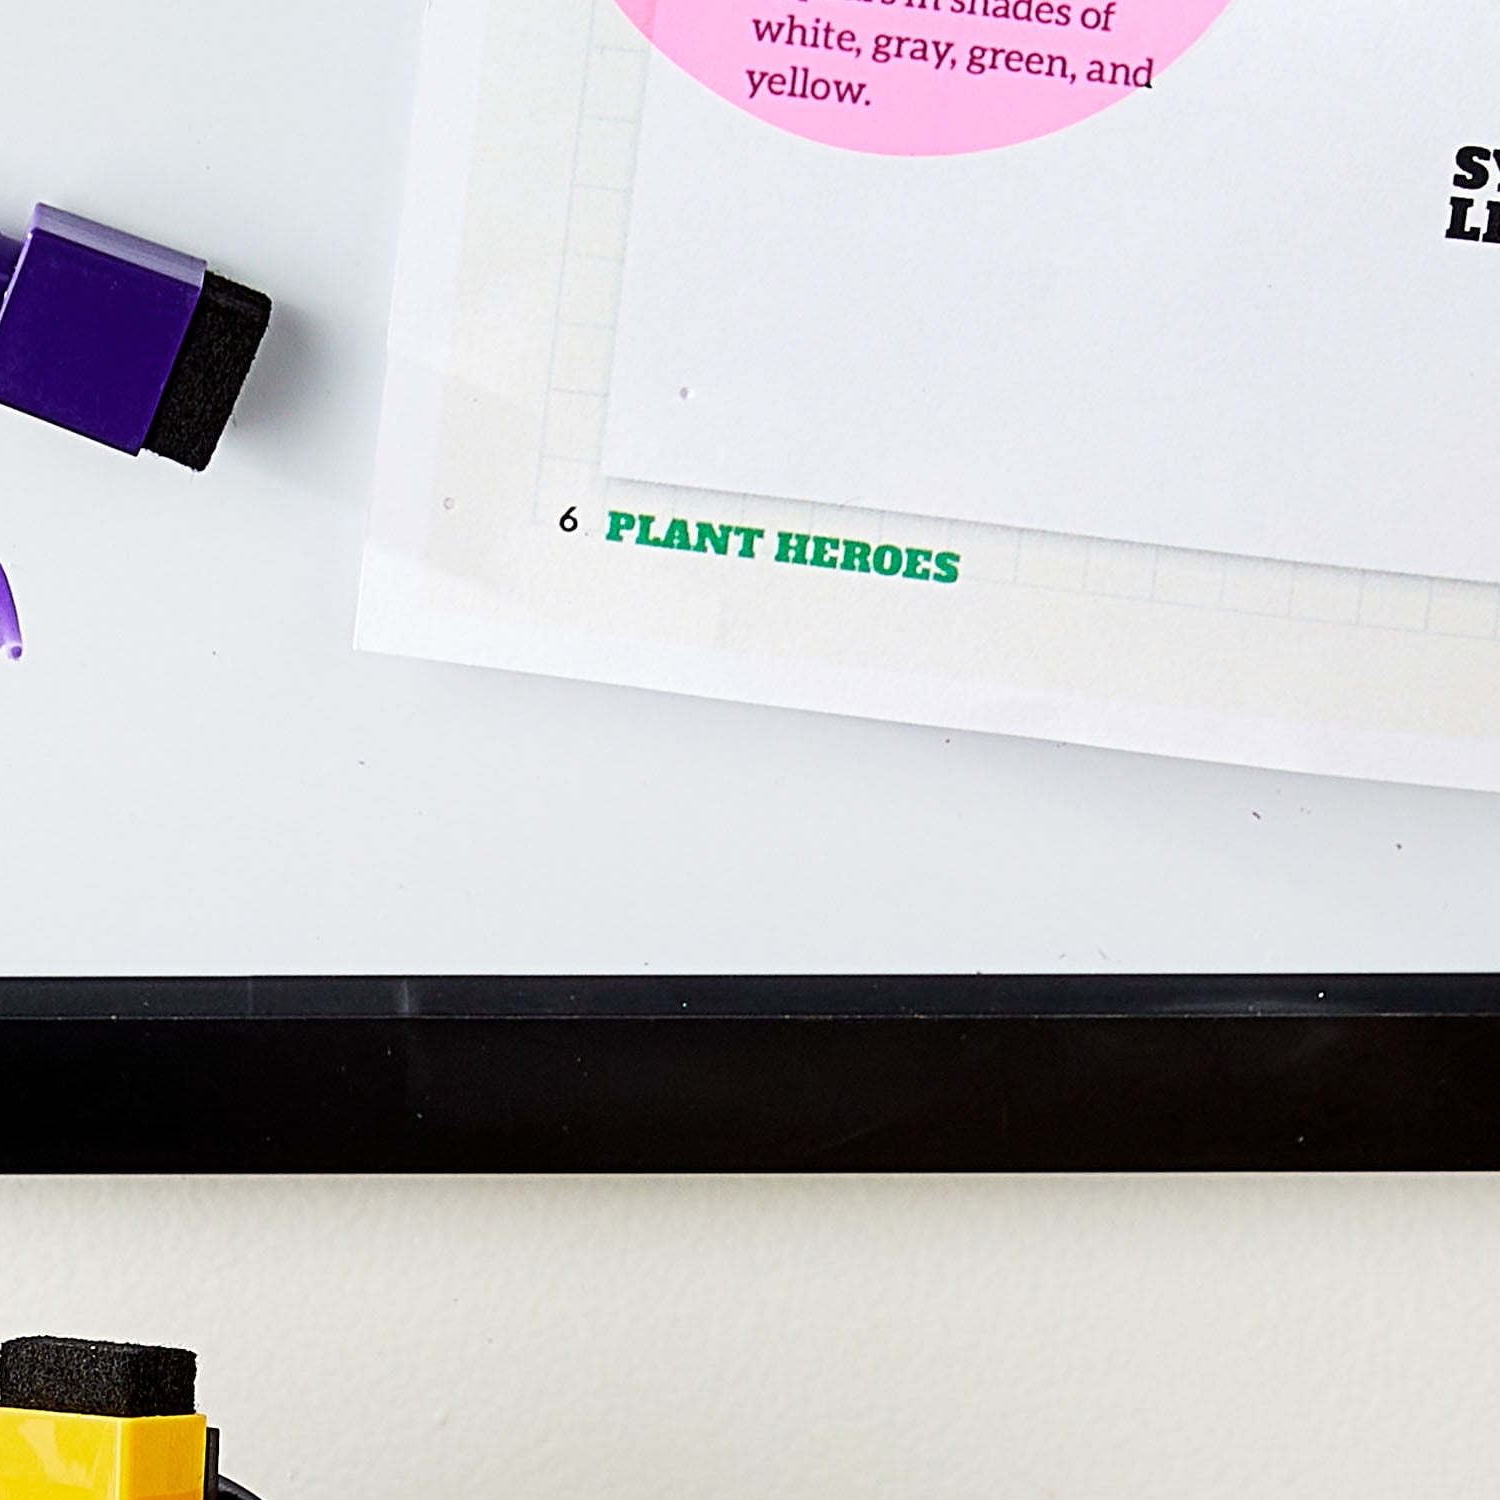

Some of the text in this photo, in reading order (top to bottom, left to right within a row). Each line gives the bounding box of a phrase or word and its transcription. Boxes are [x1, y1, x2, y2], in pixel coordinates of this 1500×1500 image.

[1080, 1, 1117, 33] of
[751, 13, 1155, 89] white, gray, green, and
[745, 65, 871, 107] yellow.
[559, 506, 960, 584] 6 PLANT HEROES
